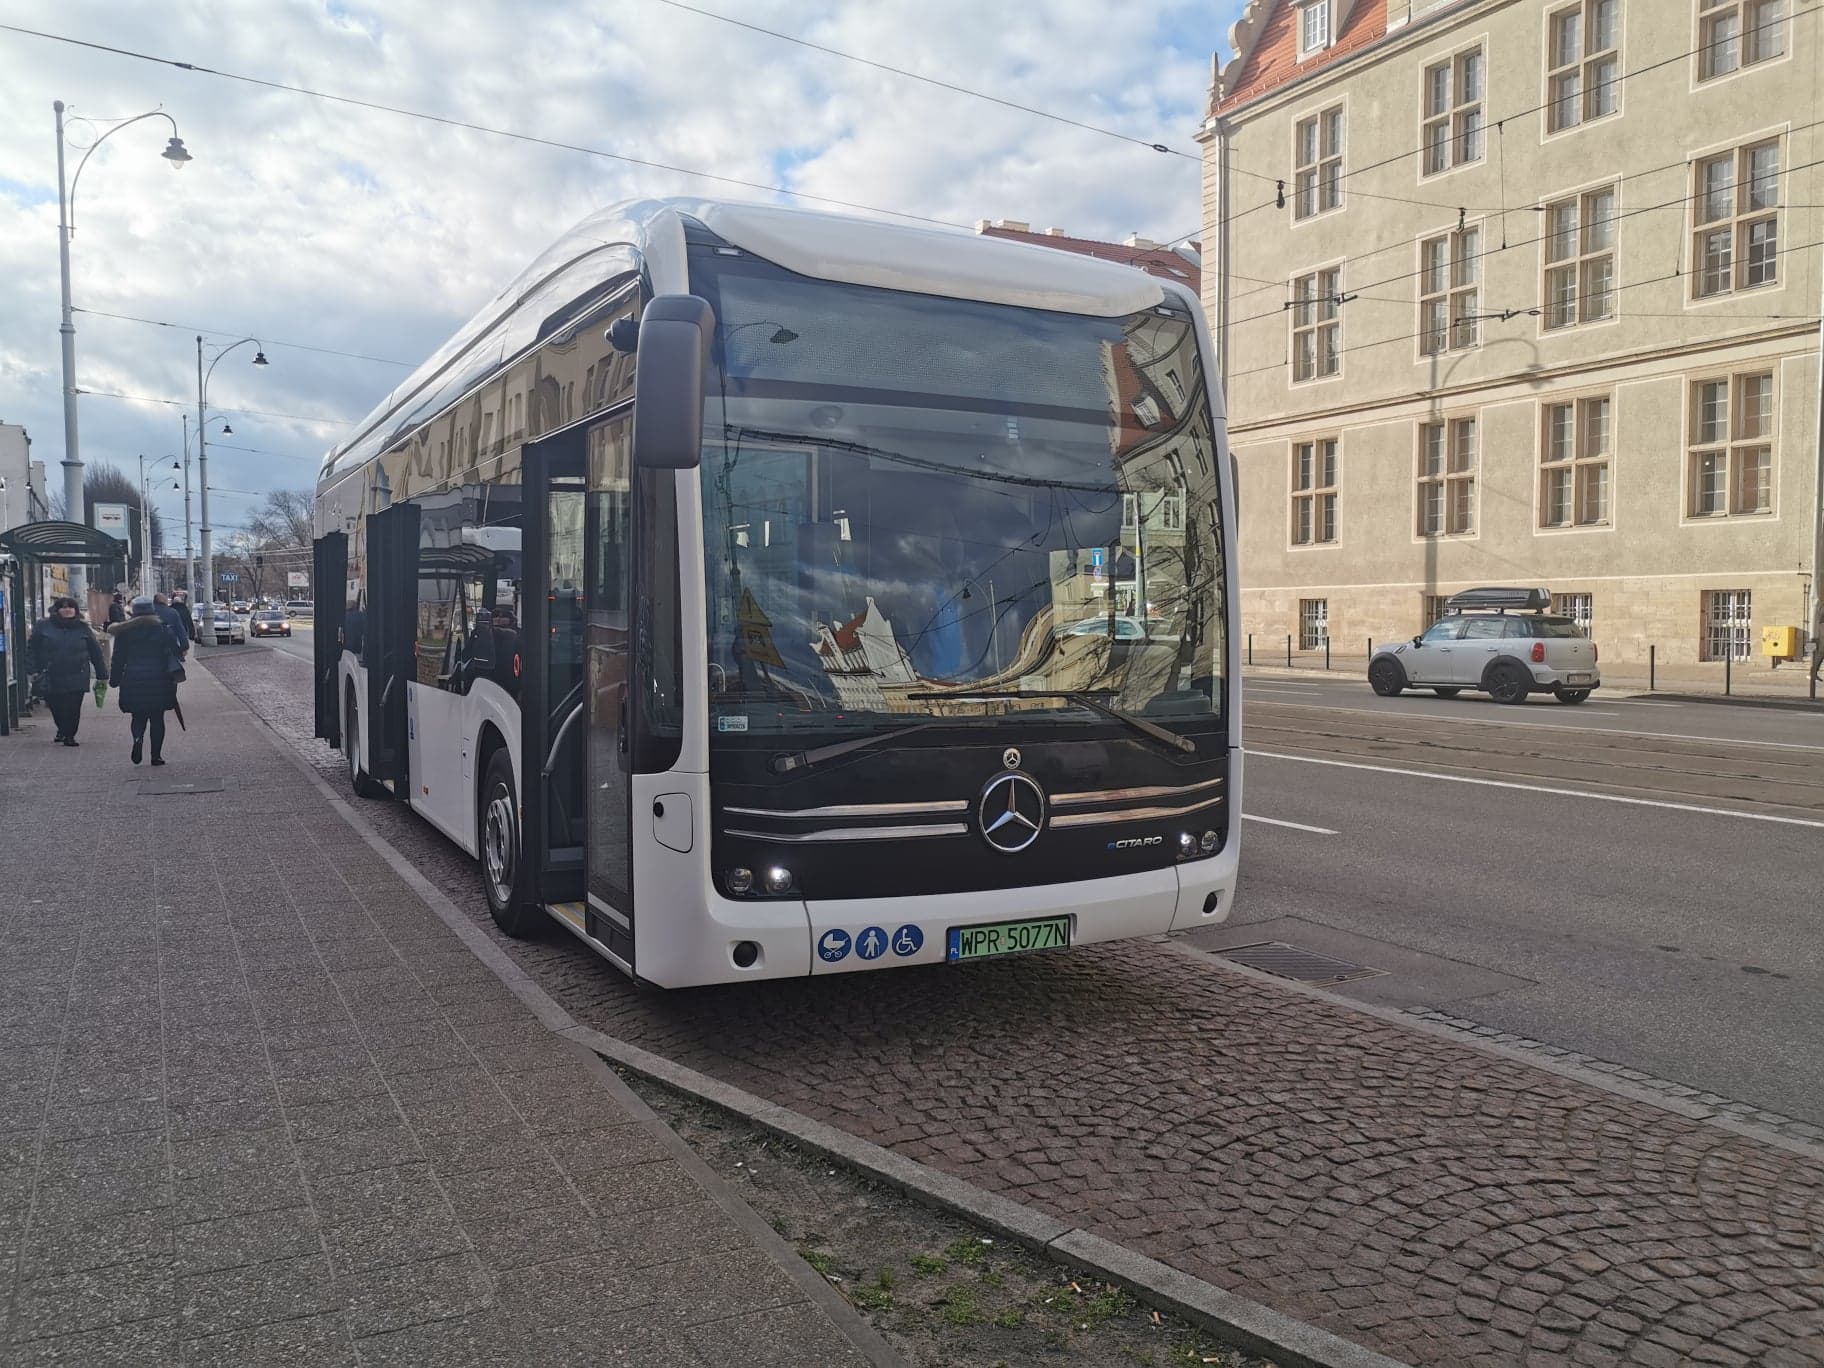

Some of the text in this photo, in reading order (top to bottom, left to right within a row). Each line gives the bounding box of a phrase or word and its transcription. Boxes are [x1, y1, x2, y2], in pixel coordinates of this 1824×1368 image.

[221, 573, 238, 581] TAXI
[961, 922, 1067, 955] WPR 5077N
